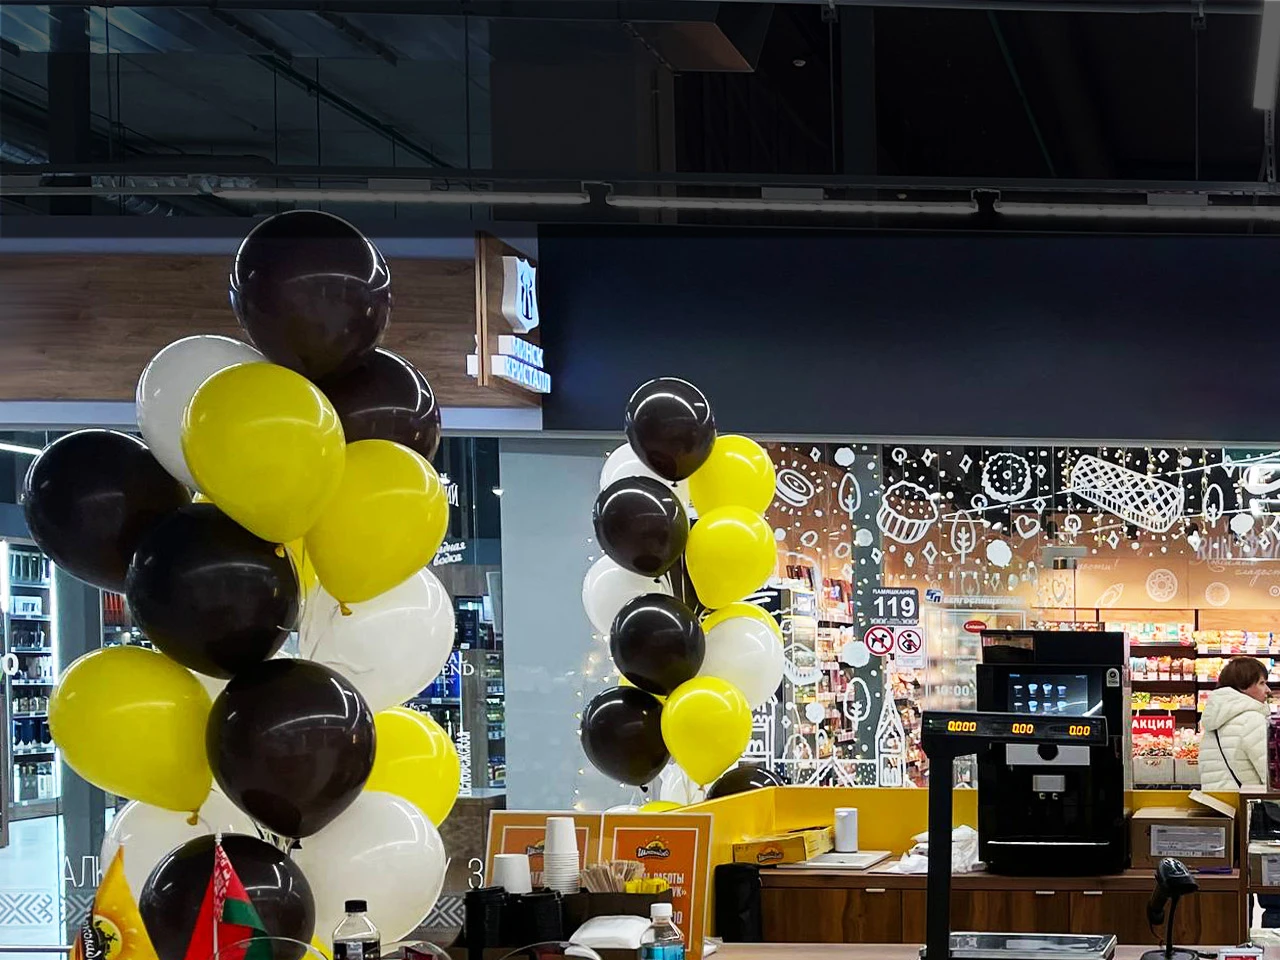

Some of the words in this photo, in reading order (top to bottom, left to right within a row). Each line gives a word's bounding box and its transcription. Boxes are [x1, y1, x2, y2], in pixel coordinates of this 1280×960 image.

[513, 336, 544, 368] МИНСК
[505, 355, 551, 393] КРИСТАЛЛ
[873, 596, 915, 618] 119
[1132, 719, 1173, 731] АКЦИЯ
